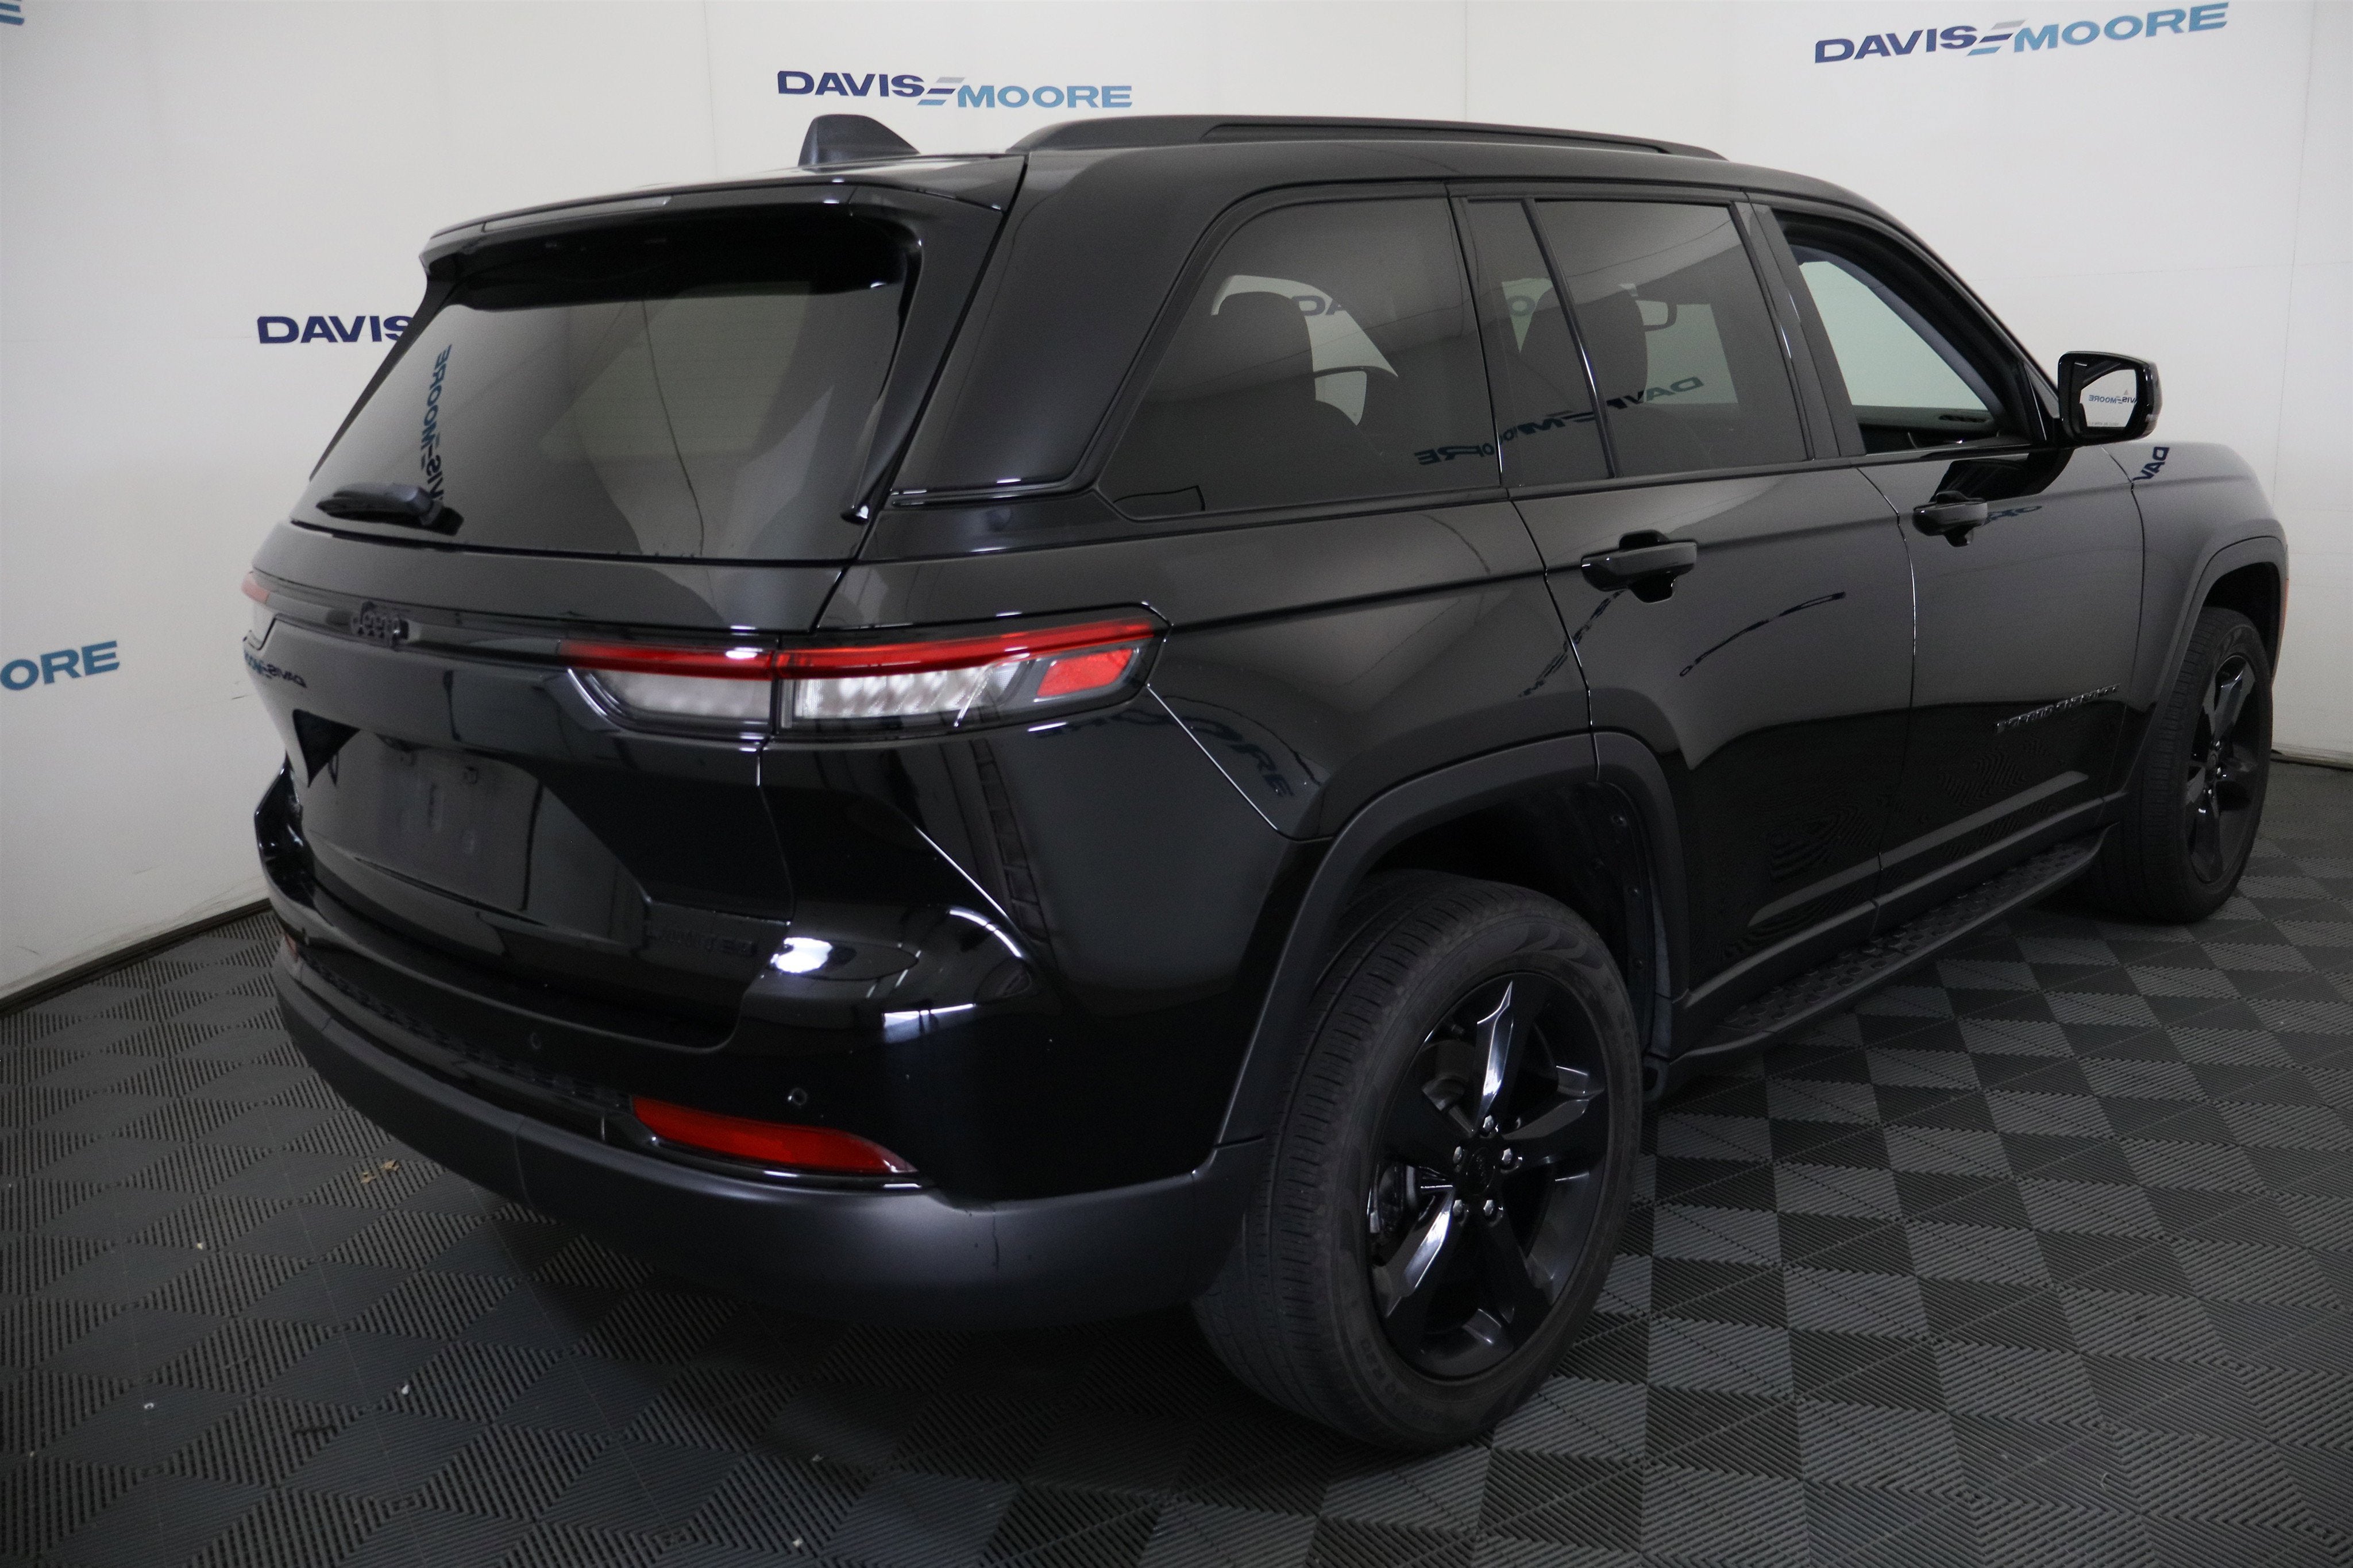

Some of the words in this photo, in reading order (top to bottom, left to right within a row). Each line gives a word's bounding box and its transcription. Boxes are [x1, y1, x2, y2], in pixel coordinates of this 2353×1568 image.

[1814, 26, 1976, 64] DAVIS
[2013, 2, 2229, 53] MOORE
[777, 71, 925, 98] DAVIS
[957, 85, 1133, 108] MOORE
[257, 315, 414, 344] DAVIS
[0, 640, 120, 690] ORE
